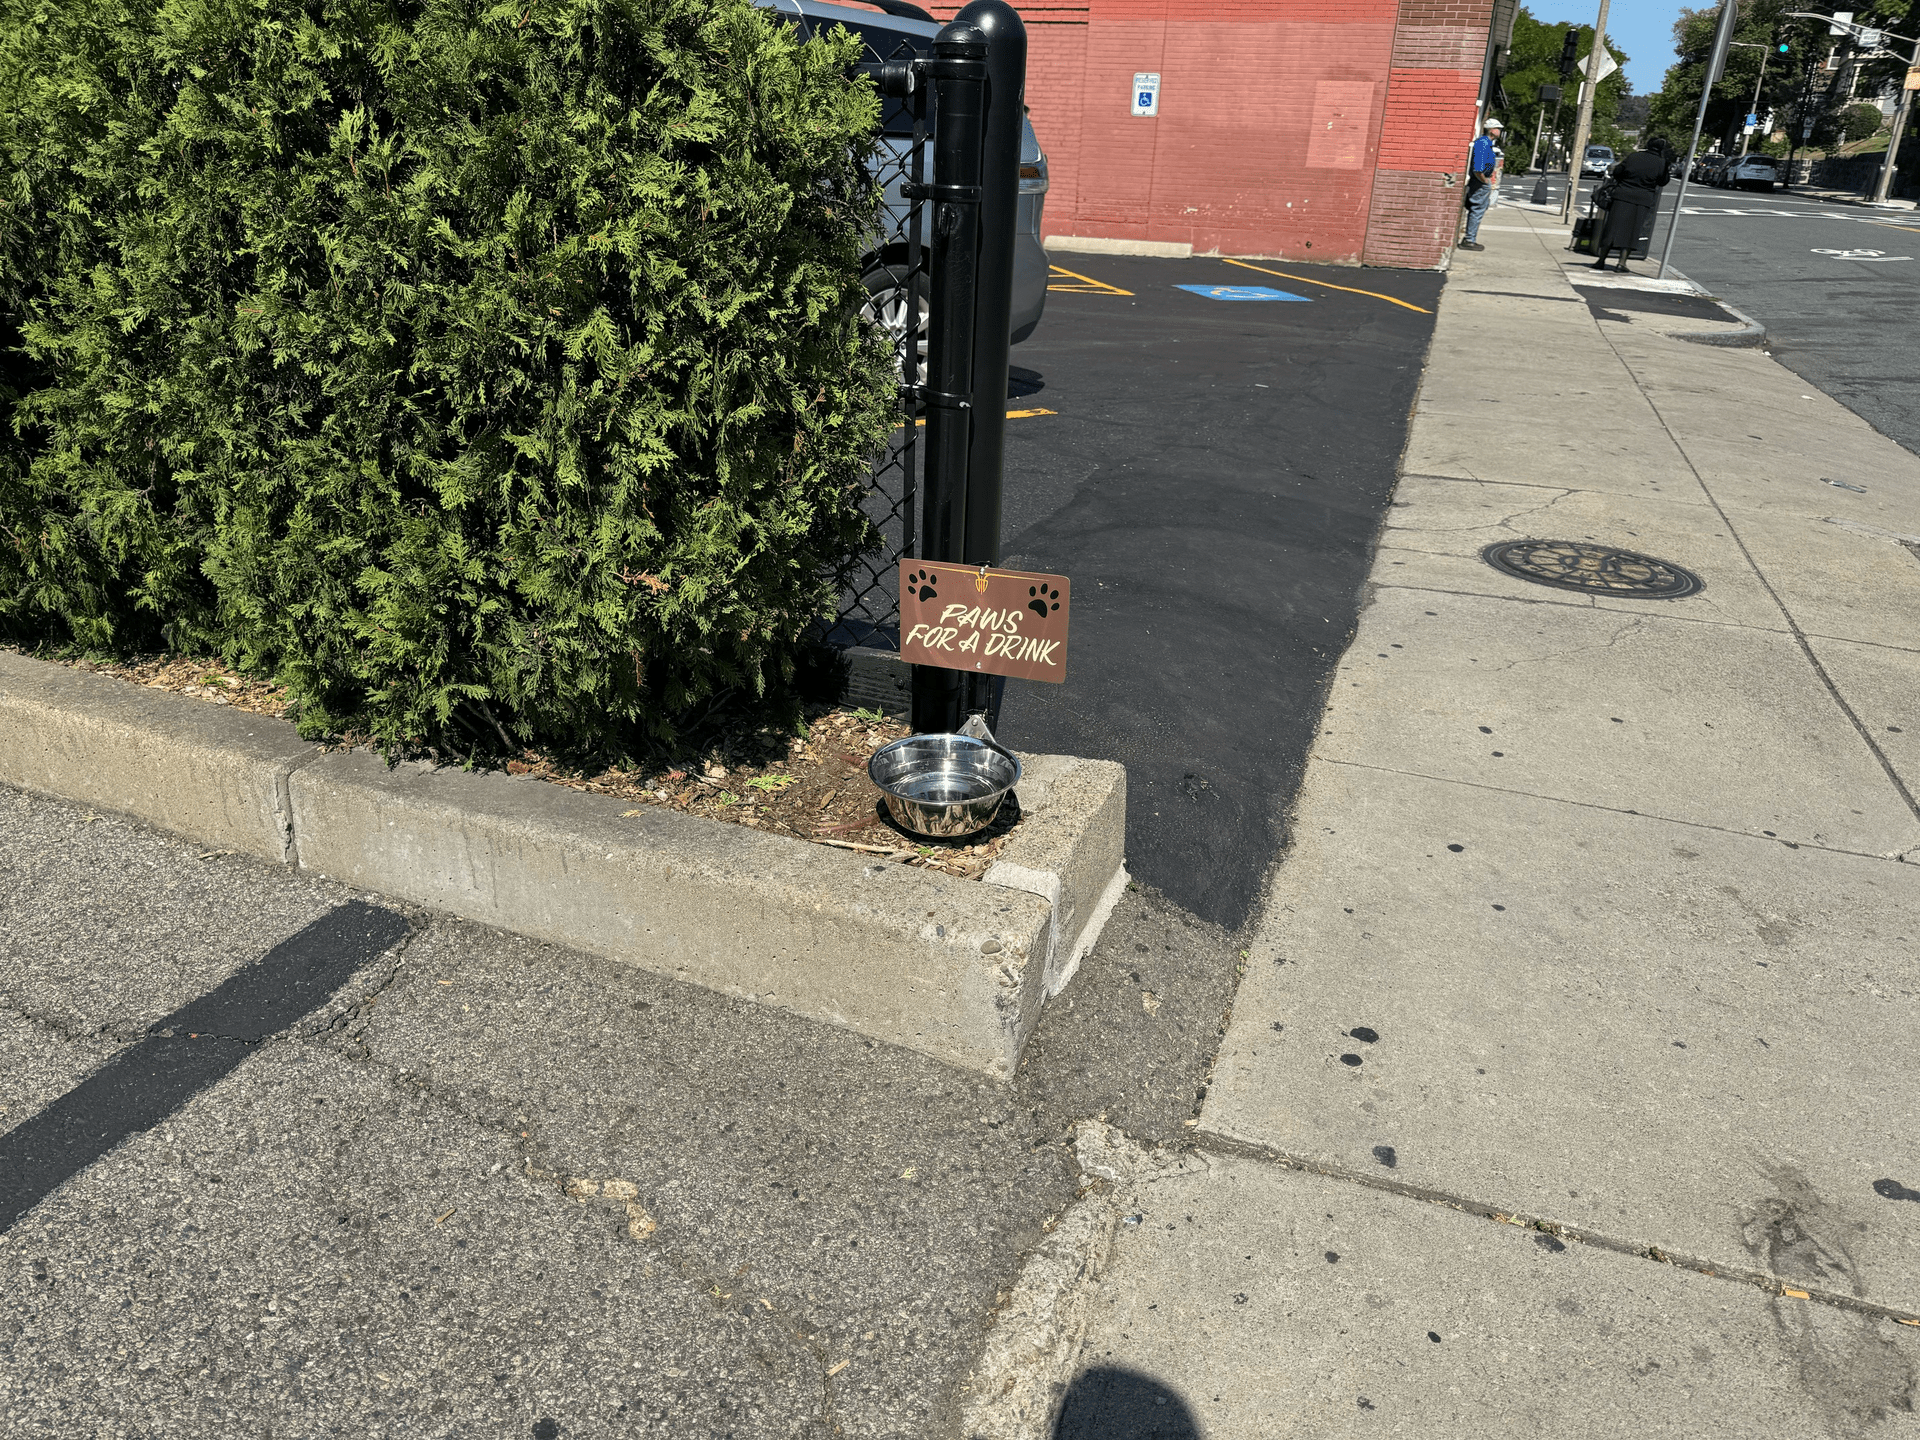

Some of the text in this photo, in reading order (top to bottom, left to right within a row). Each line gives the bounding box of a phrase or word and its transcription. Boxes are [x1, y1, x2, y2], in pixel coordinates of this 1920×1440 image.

[939, 603, 1024, 634] PAWS
[905, 623, 1061, 666] FOR A DRINK
